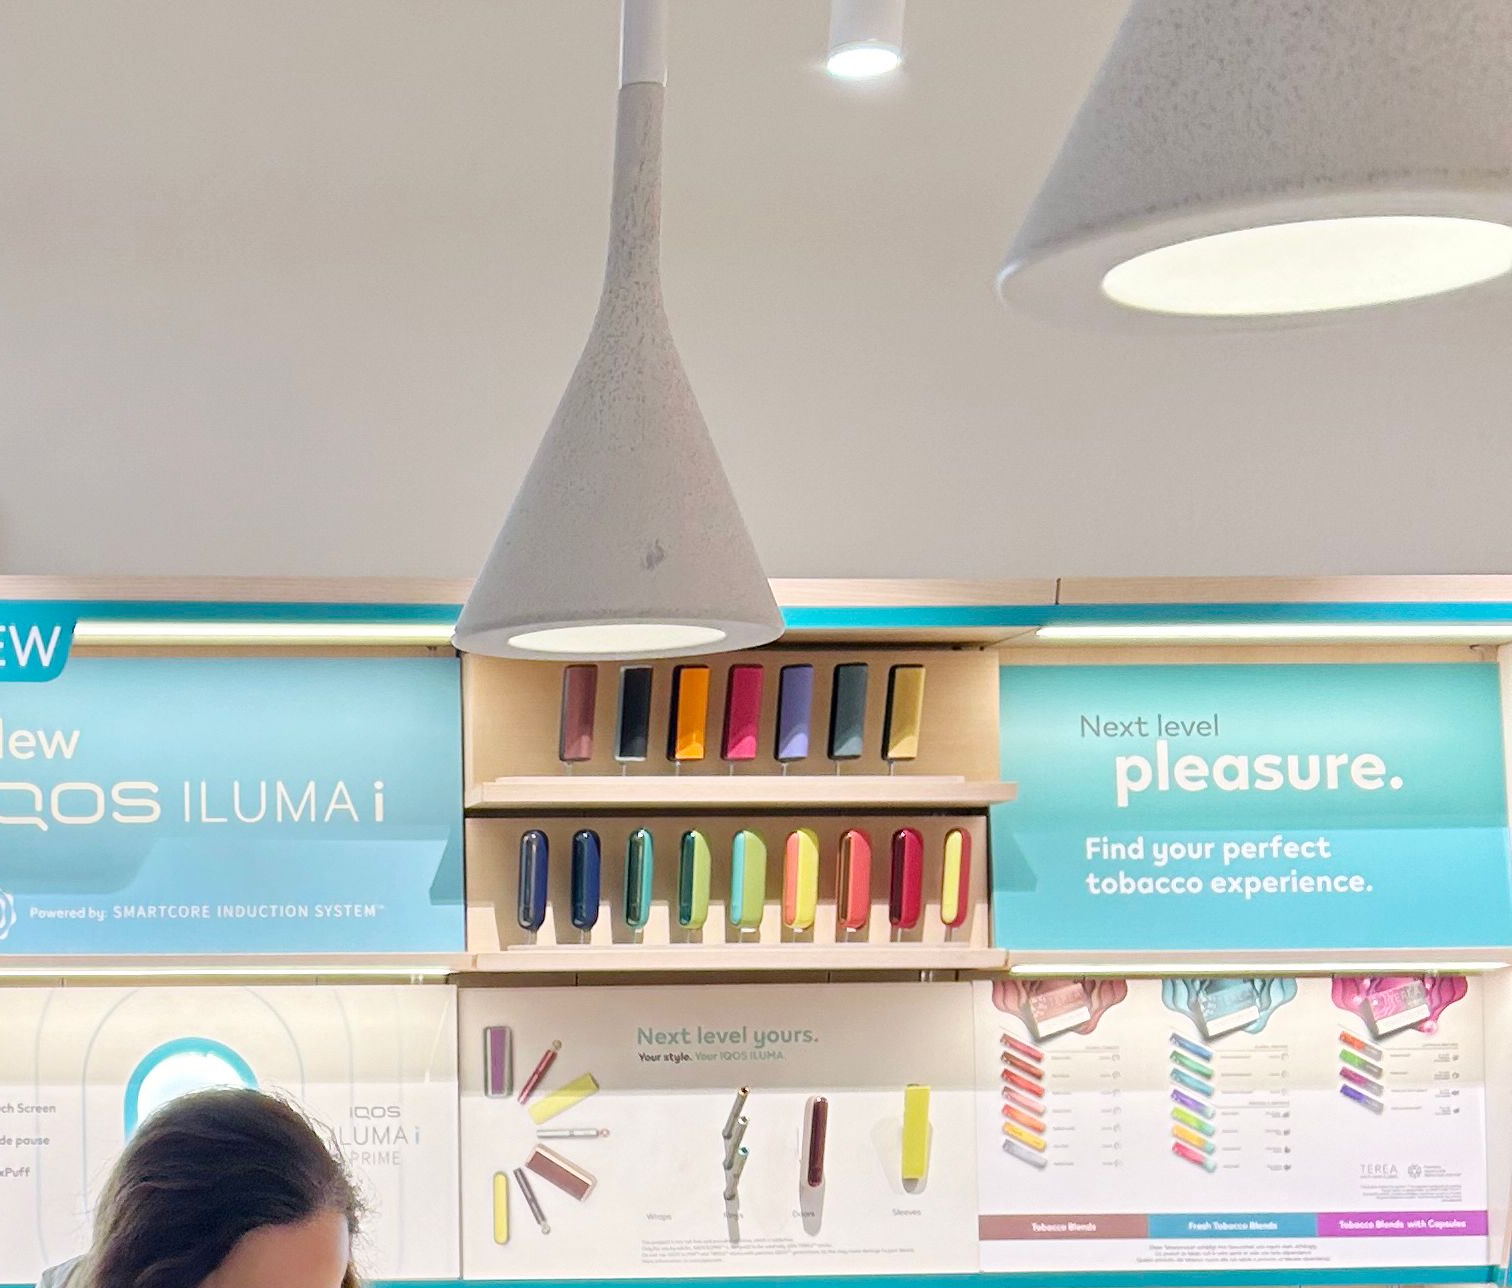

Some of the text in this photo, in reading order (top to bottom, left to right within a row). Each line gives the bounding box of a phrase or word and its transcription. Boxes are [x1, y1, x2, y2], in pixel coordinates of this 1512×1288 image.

[1080, 713, 1220, 738] Next level
[1115, 739, 1404, 807] pleasure.
[184, 780, 359, 823] ILUMA
[373, 780, 385, 823] i
[1086, 835, 1331, 866] Find your perfect
[1086, 869, 1373, 899] tobacco experience.
[30, 905, 85, 919] Powered
[113, 905, 211, 920] SMARTCORE
[217, 904, 309, 919] INDUCTION
[637, 1026, 819, 1048] Next level yours.
[639, 1053, 661, 1062] Your
[720, 1051, 747, 1061] IQOS
[23, 1103, 56, 1114] Screen
[349, 1105, 401, 1120] IQOS
[15, 1136, 50, 1149] pause
[349, 1151, 401, 1166] PRIME
[1032, 1222, 1096, 1232] Tobacco Blends
[1188, 1220, 1278, 1231] Fresh Tobacco Blends
[1340, 1218, 1466, 1230] Tobacco Blends with Capsules
